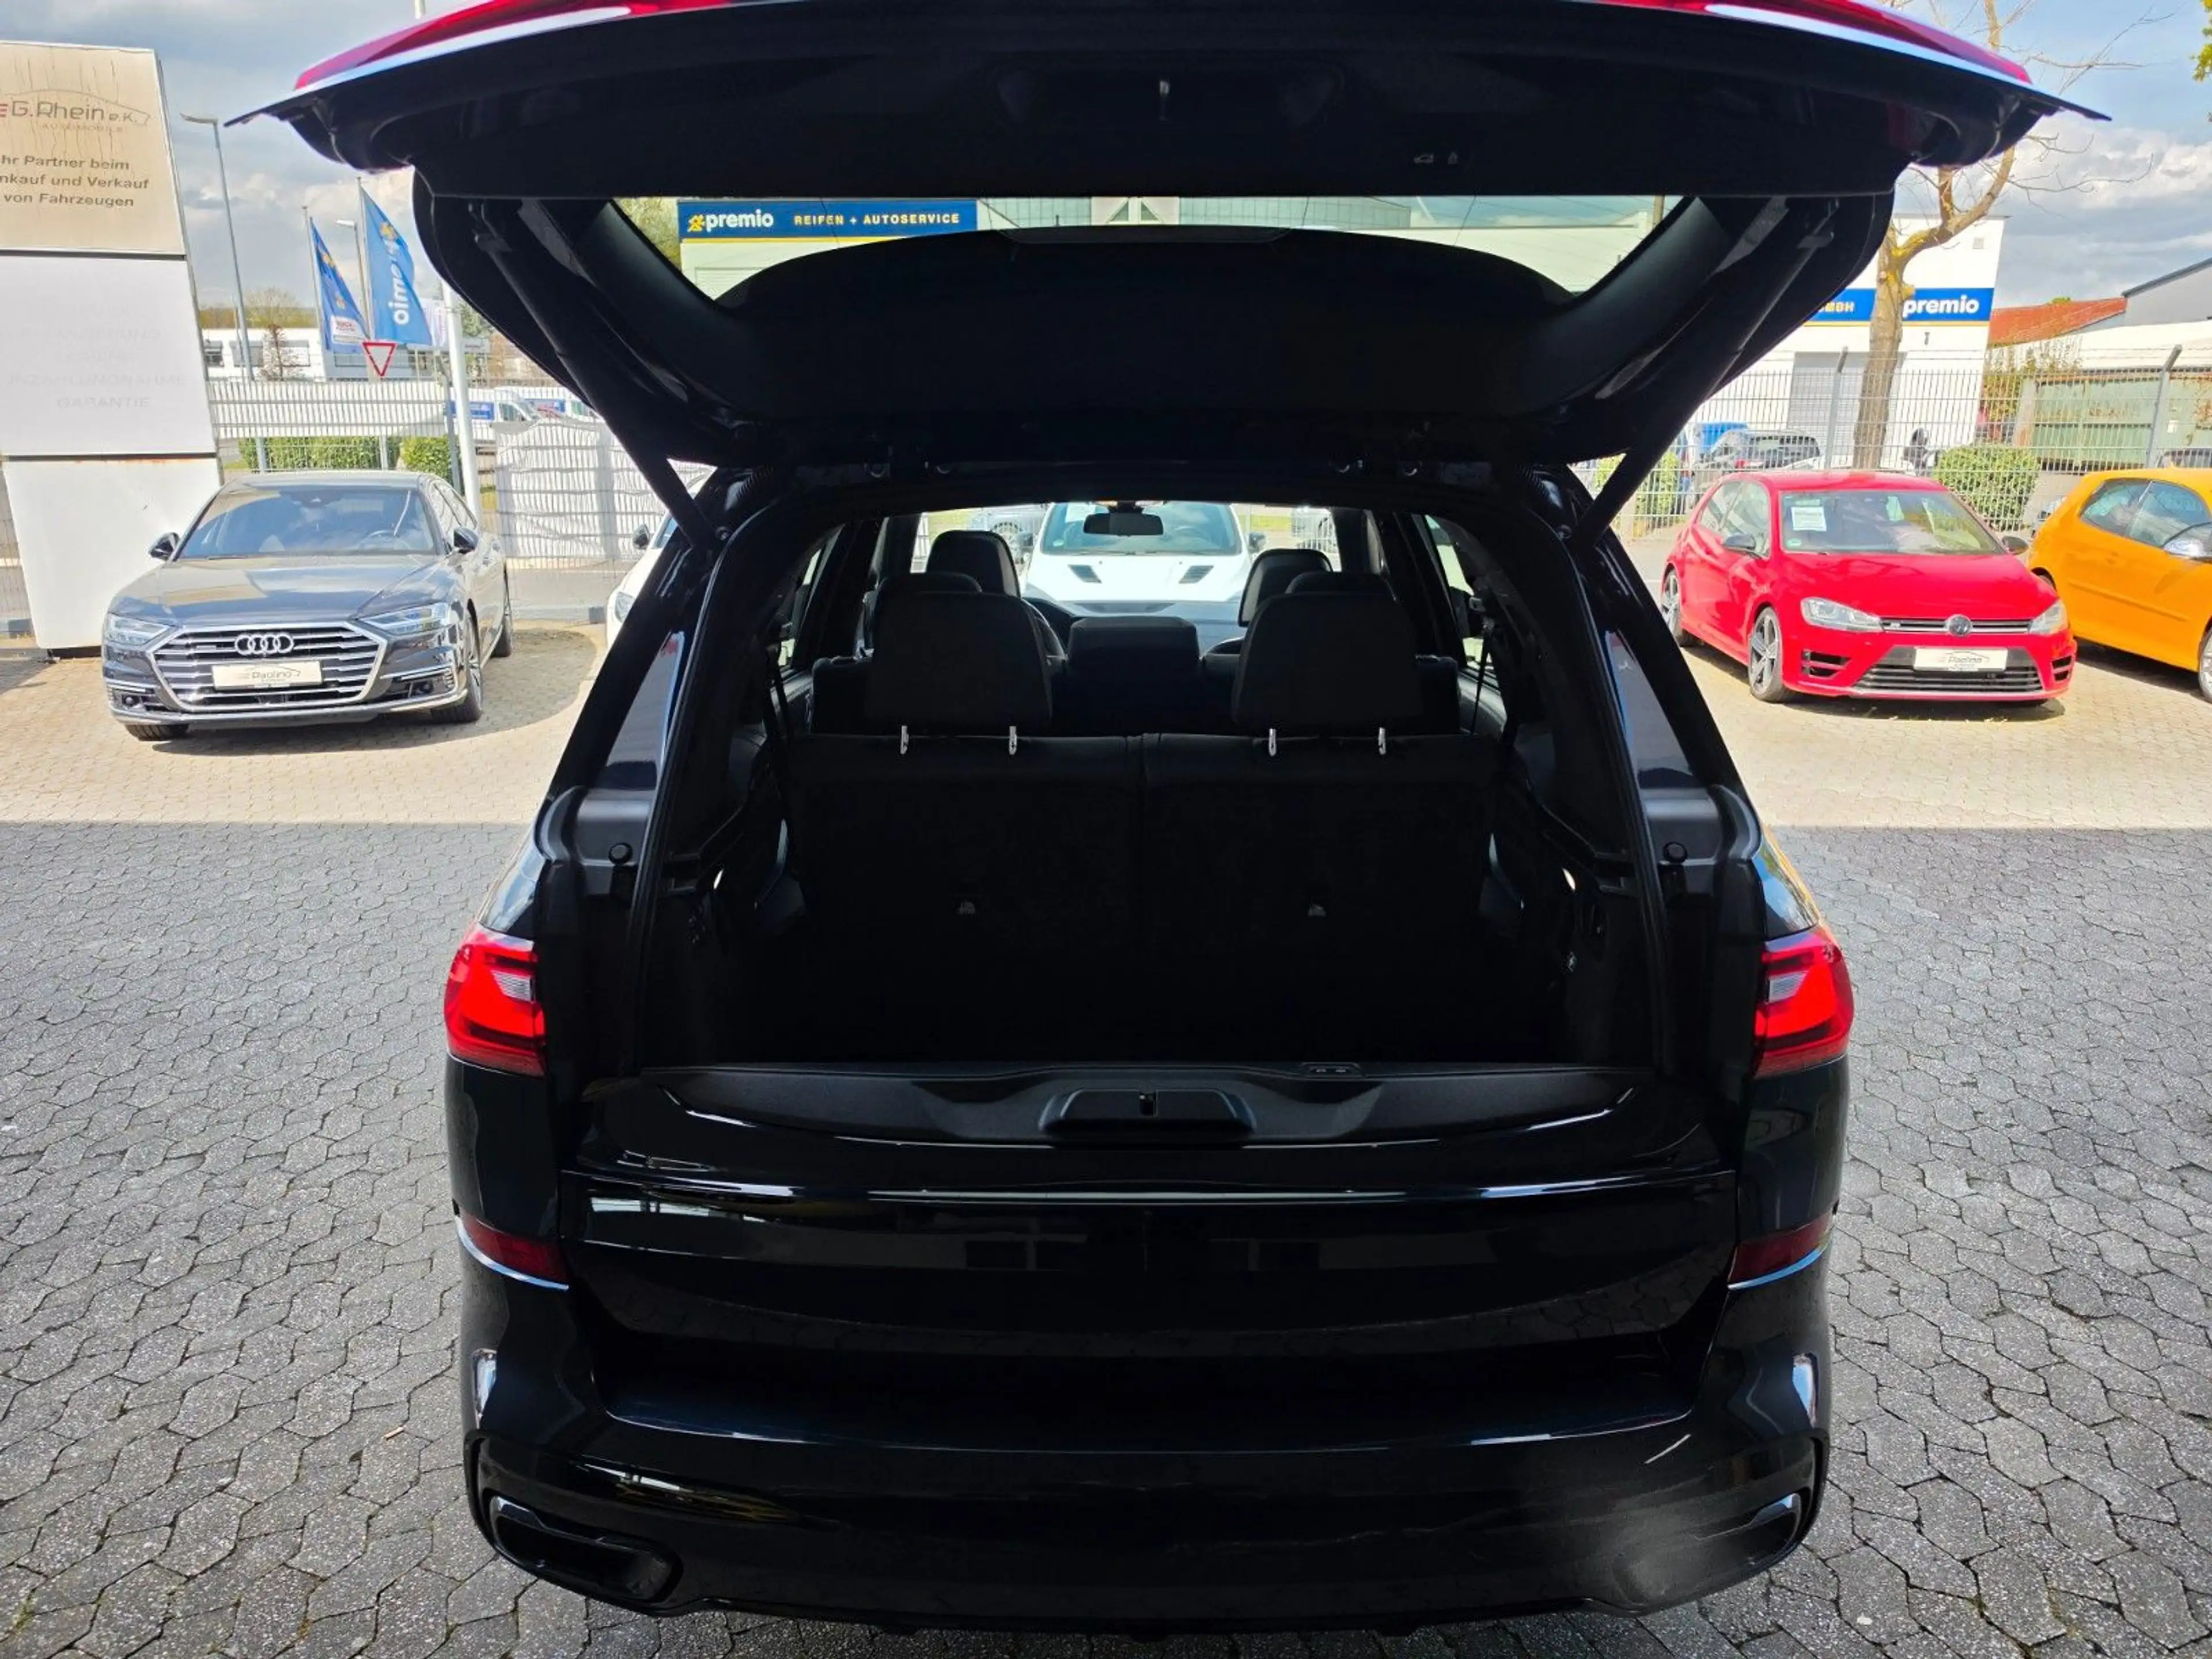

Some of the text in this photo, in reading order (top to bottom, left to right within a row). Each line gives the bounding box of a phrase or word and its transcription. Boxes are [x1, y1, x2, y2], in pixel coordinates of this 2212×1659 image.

[24, 155, 86, 168] Partner
[90, 158, 130, 170] beim
[51, 176, 82, 187] und
[87, 176, 150, 189] Verkauf
[4, 193, 134, 207] von Fahrzeugen
[706, 208, 774, 232] premio
[794, 214, 845, 226] REIFEN
[863, 213, 960, 225] AUTOSERVICE
[1902, 294, 1980, 318] premio
